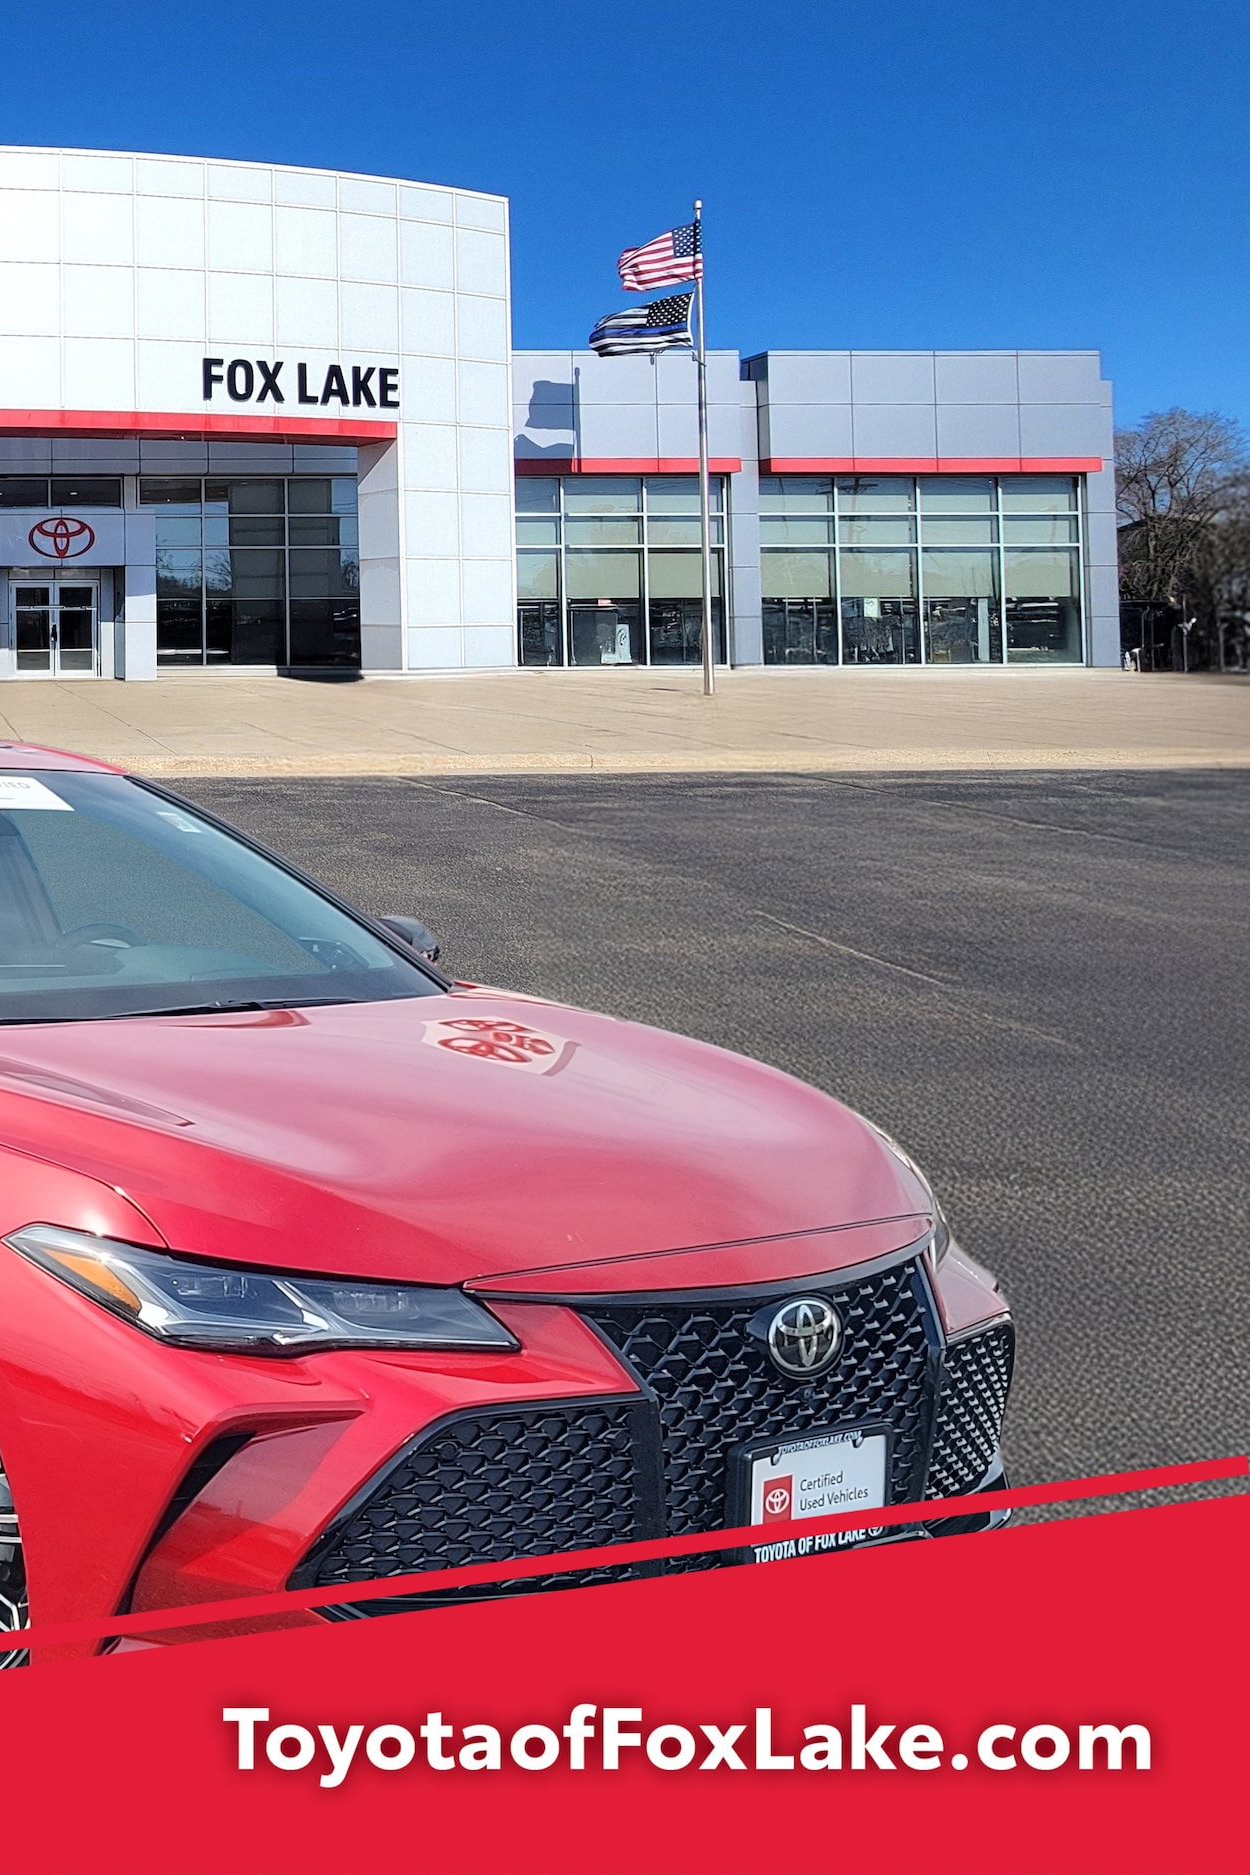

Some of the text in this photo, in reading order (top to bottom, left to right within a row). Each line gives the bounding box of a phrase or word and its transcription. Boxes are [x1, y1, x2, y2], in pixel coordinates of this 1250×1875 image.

[202, 358, 401, 409] FOX LAKE
[800, 1471, 844, 1492] Certified
[800, 1487, 869, 1511] Used Vehicles
[754, 1540, 796, 1564] TOYOTA
[798, 1536, 814, 1555] OF
[814, 1533, 837, 1551] FOX
